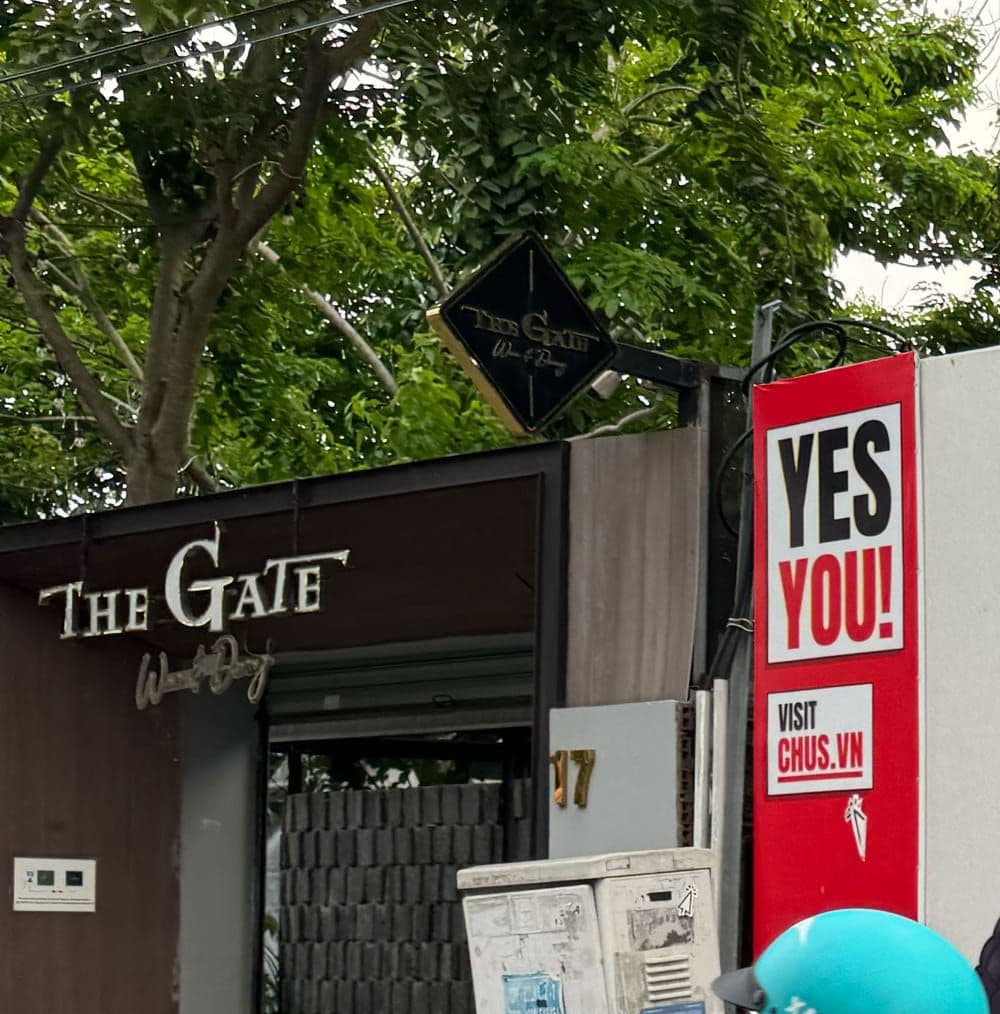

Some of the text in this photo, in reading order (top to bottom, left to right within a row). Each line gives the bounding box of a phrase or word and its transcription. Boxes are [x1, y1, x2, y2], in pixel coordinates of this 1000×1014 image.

[777, 419, 892, 548] YES
[38, 520, 351, 640] THE GATE
[778, 545, 893, 650] YOU!
[777, 731, 864, 774] CHUS.VN
[778, 701, 818, 732] VISIT
[548, 749, 597, 808] 17
